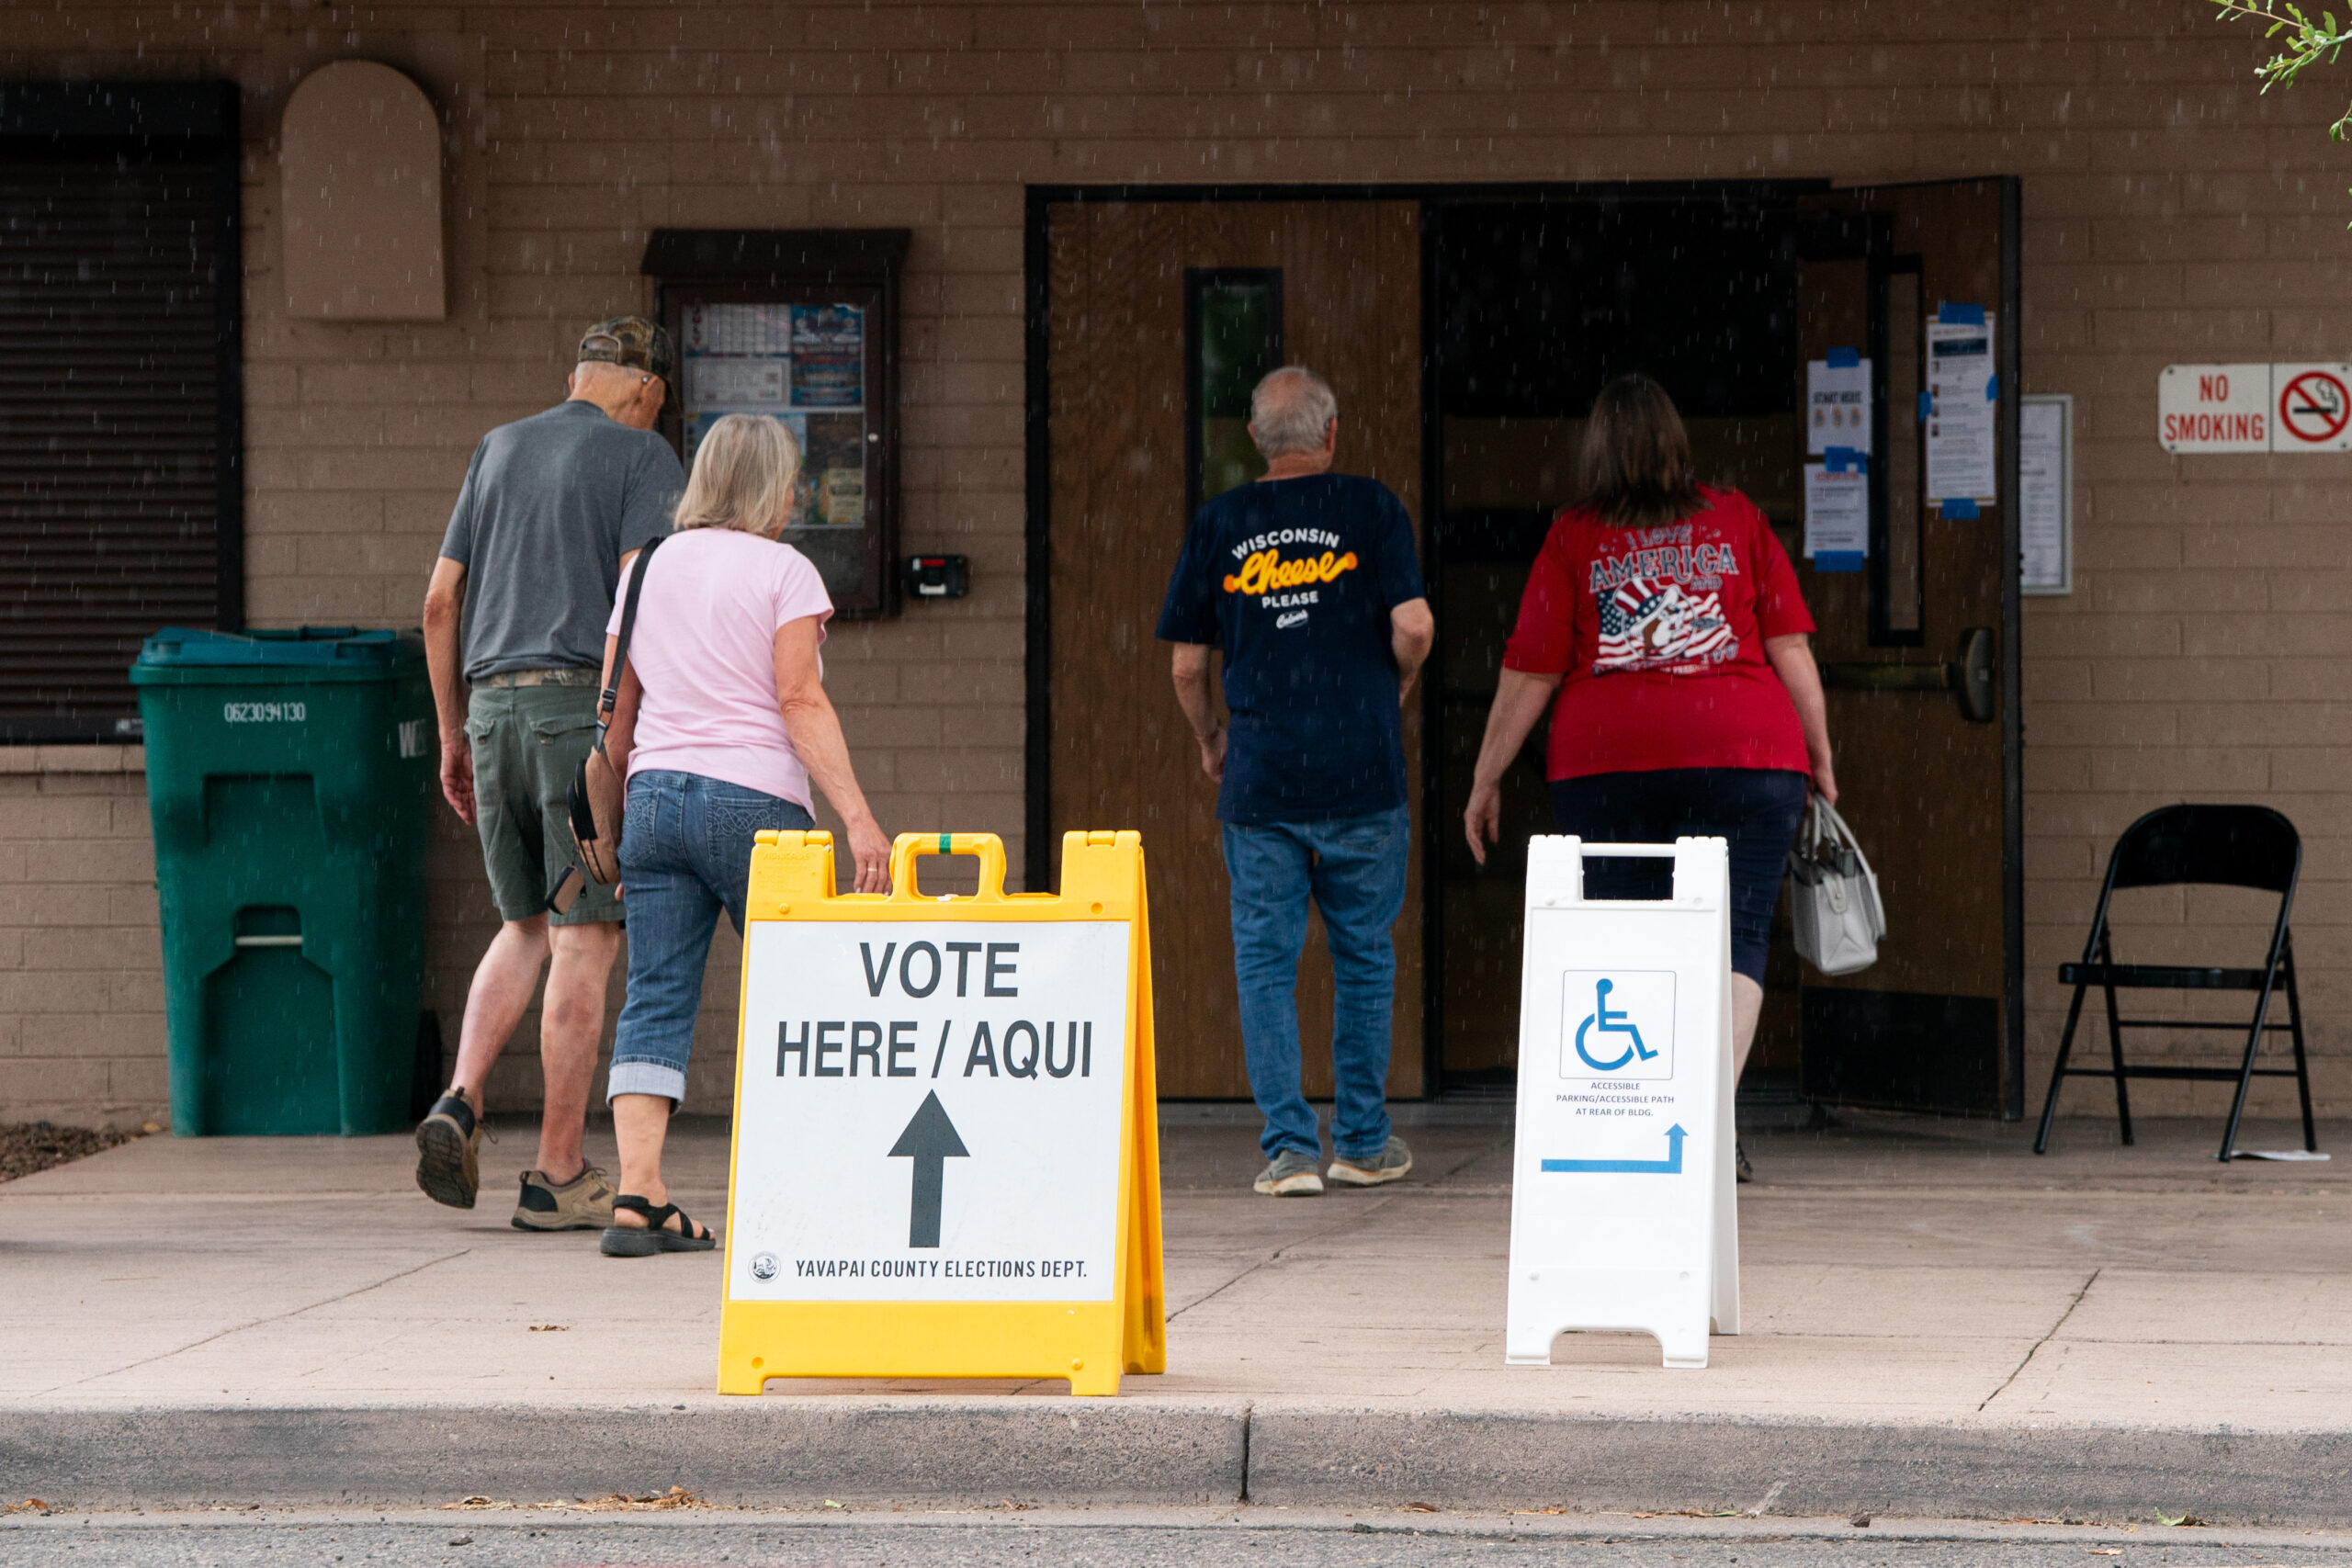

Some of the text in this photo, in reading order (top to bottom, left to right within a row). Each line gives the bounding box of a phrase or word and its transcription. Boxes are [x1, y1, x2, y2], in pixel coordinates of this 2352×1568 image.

[2199, 374, 2229, 402] NO
[2165, 413, 2265, 441] SMOKING
[1231, 527, 1340, 560] WISCONSIN
[1624, 525, 1693, 550] I LOVE
[1223, 548, 1358, 595] Cheese
[1588, 543, 1739, 593] AMERICA
[1261, 591, 1319, 609] PLEASE
[224, 702, 306, 723] 0623094130
[860, 941, 1020, 998] VOTE
[775, 1021, 919, 1077] HERE
[963, 1020, 1092, 1081] AQUI
[1556, 1094, 1649, 1104] PARKING/ACCESSIBLE
[1590, 1082, 1640, 1090] ACCESSIBLE
[1576, 1108, 1587, 1116] AT
[1589, 1108, 1611, 1116] REAR
[1628, 1109, 1654, 1117] BLDG.
[796, 1259, 865, 1278] YAVAPAI
[871, 1259, 939, 1278] COUNTY
[944, 1260, 1035, 1278] ELECTIONS
[1041, 1260, 1088, 1279] DEPT.
